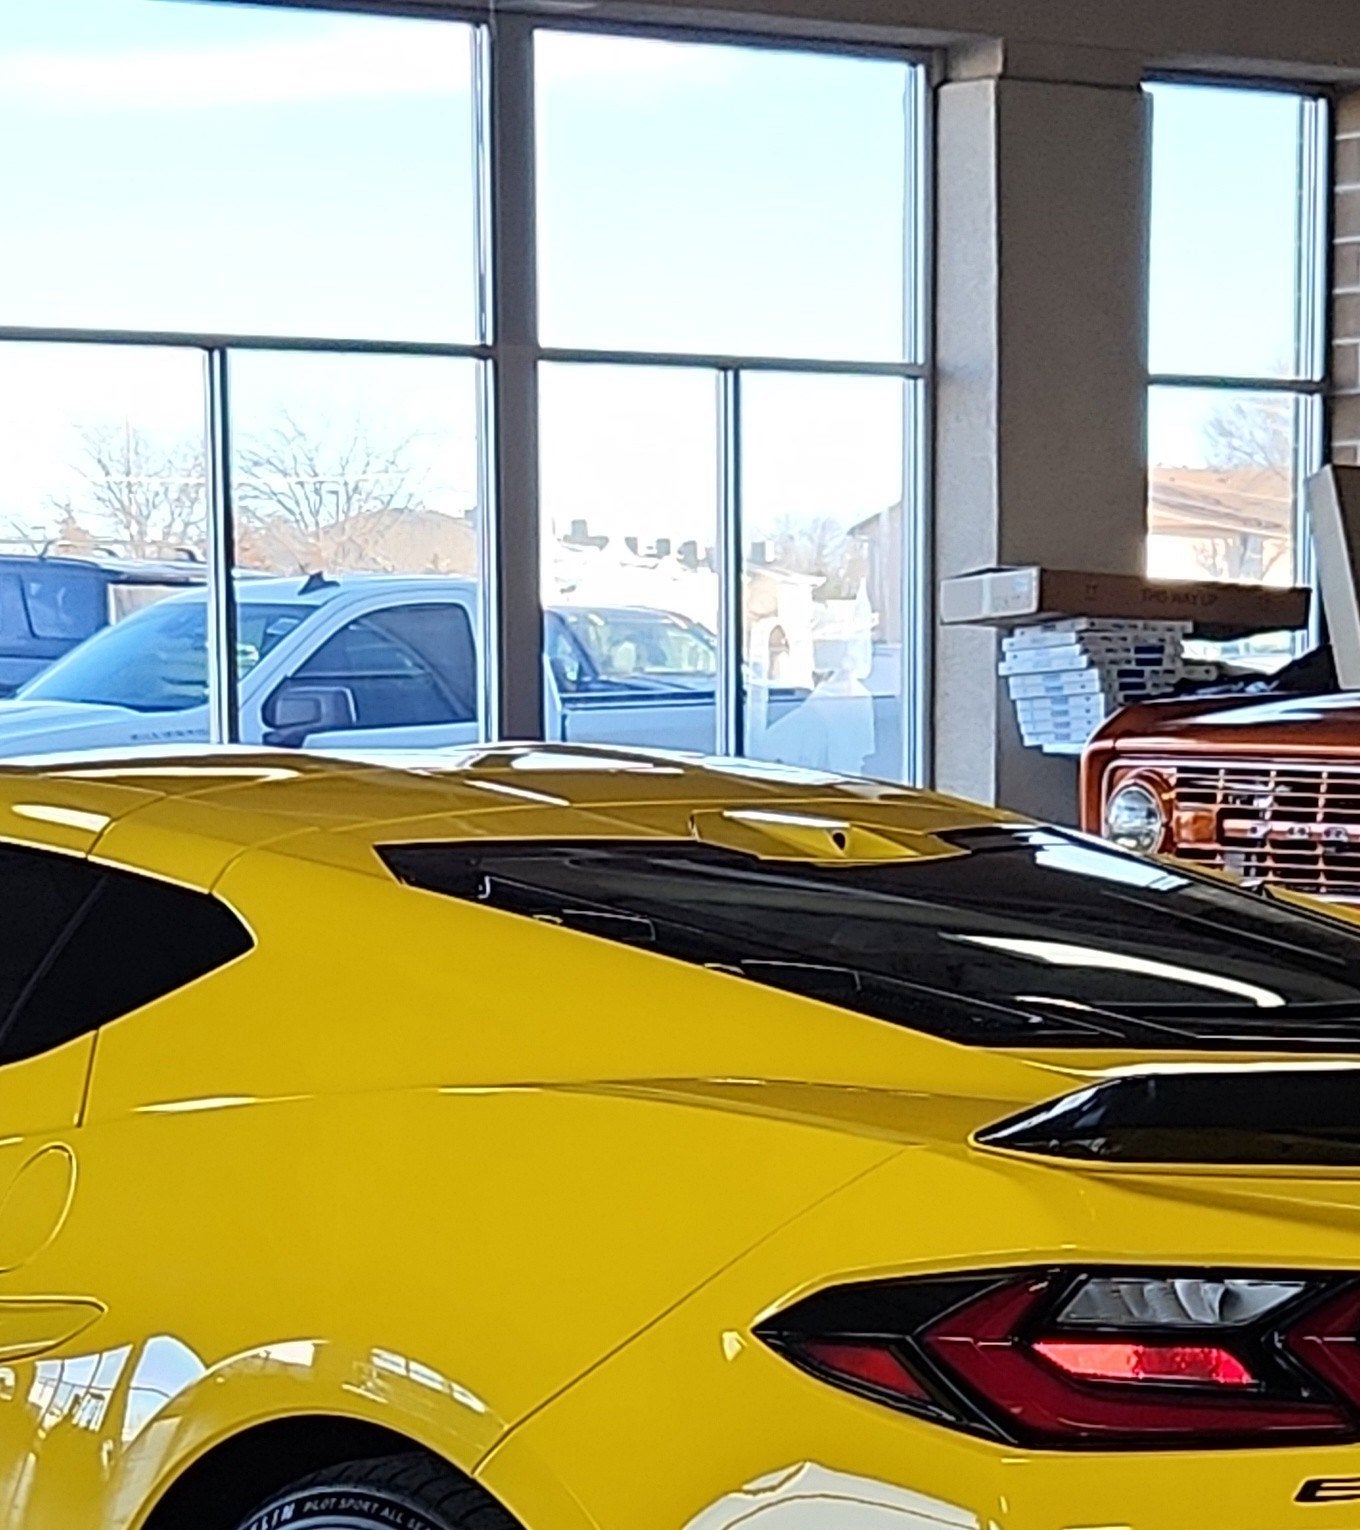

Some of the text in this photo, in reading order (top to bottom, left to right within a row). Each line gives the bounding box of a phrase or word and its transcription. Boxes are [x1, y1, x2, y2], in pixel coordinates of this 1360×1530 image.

[302, 1498, 337, 1513] PILOT
[339, 1498, 378, 1517] SPORT
[381, 1506, 404, 1524] ALL
